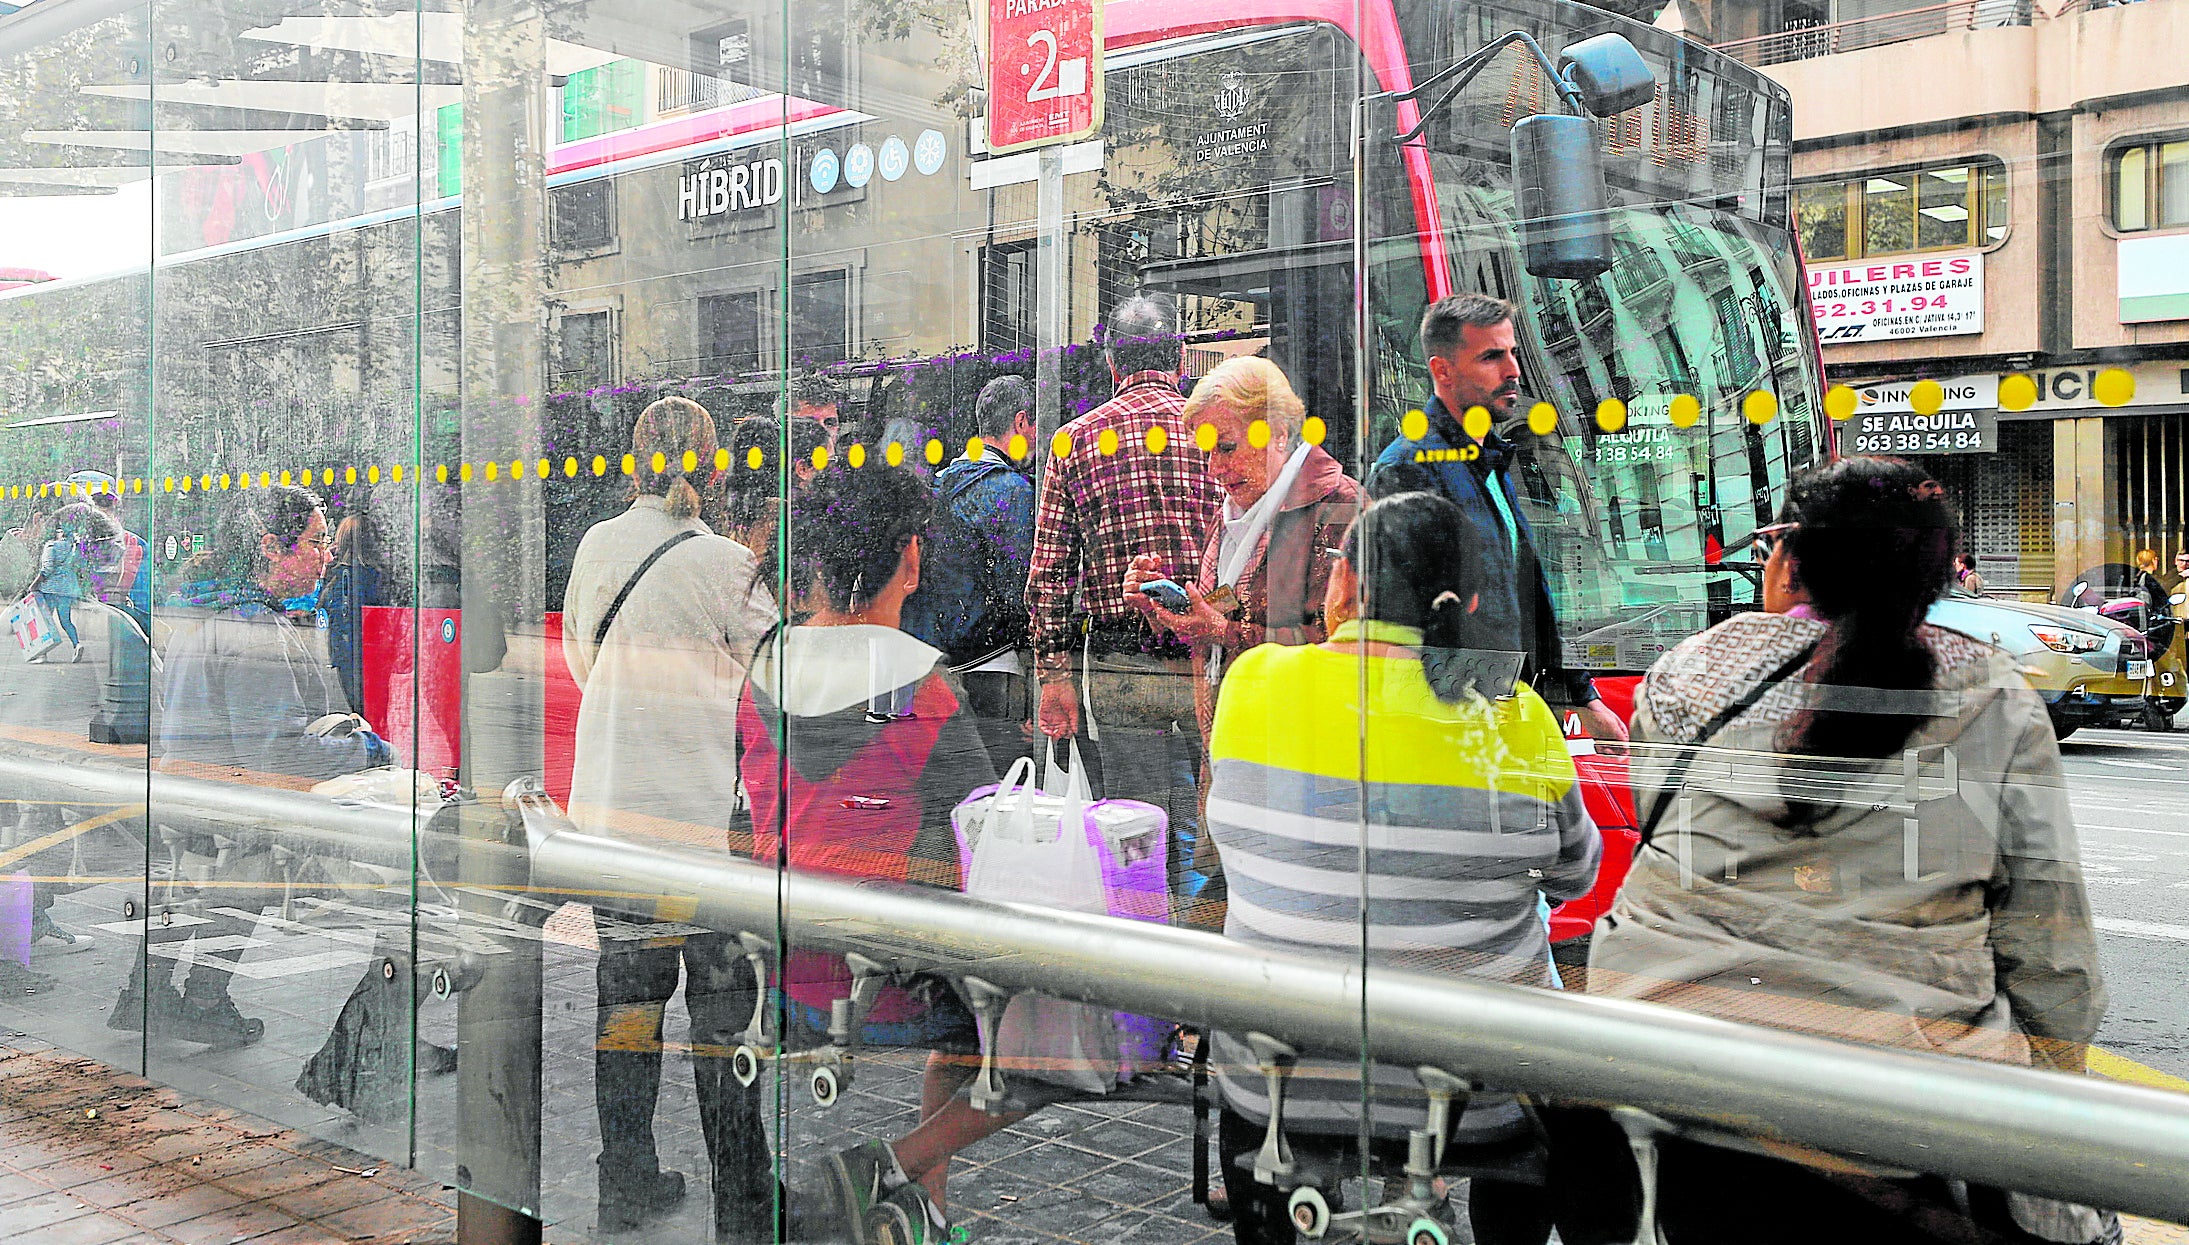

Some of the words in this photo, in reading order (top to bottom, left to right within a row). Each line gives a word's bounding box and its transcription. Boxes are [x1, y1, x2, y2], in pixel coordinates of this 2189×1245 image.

[1196, 122, 1268, 147] AJUNTAMENT
[1196, 148, 1212, 161] DE
[1214, 138, 1268, 158] VALENCIA
[678, 157, 784, 220] HÍBRID
[1890, 282, 1923, 294] PLAZAS
[1925, 280, 1936, 291] DE
[1939, 277, 1974, 290] GARAJE
[1889, 326, 1916, 335] 46002
[1919, 323, 1957, 333] Valencia
[1862, 416, 1884, 433] SE
[1889, 412, 1976, 432] ALQUILA
[1856, 434, 1892, 452] 963
[1896, 433, 1921, 451] 38
[1926, 432, 1950, 450] 54
[1955, 431, 1982, 449] 84
[1606, 446, 1627, 462] 38
[1630, 446, 1651, 461] 54
[1656, 445, 1674, 461] 84
